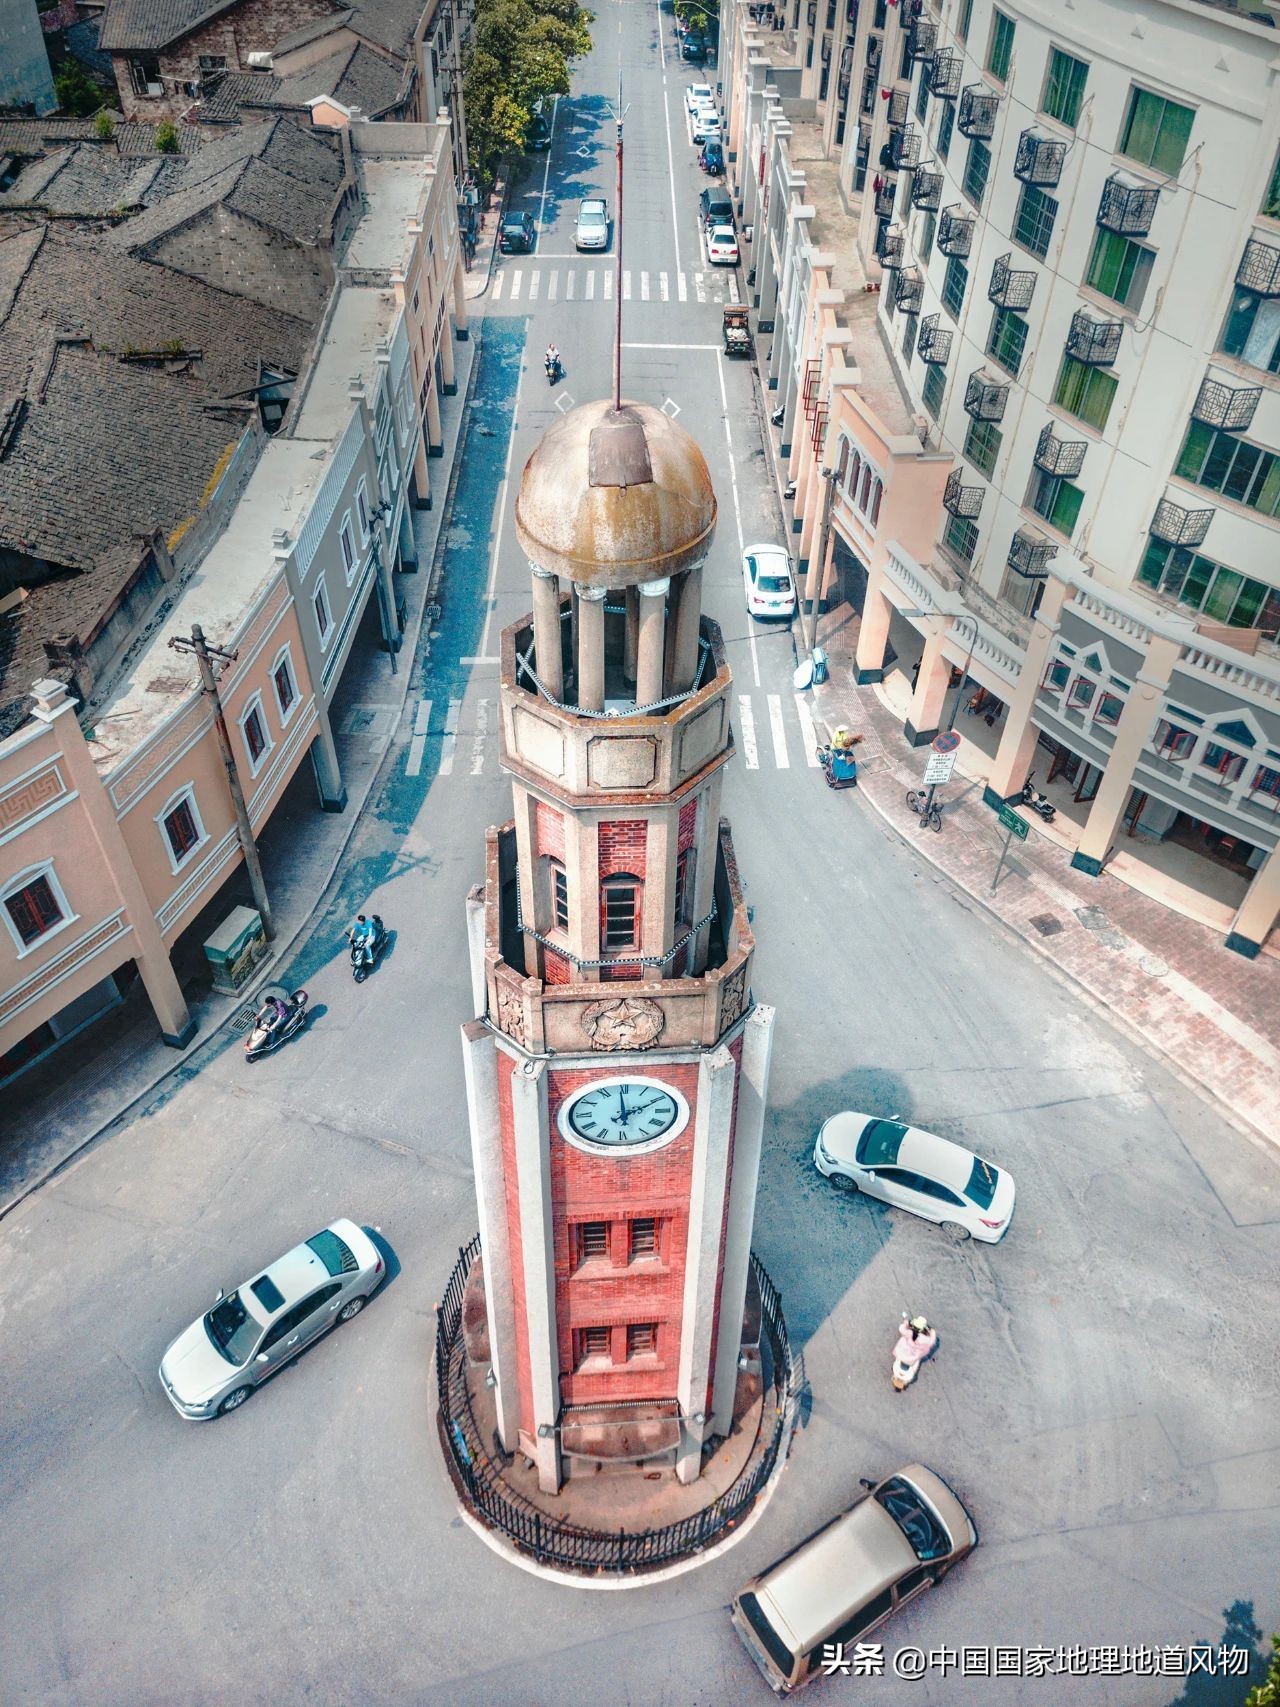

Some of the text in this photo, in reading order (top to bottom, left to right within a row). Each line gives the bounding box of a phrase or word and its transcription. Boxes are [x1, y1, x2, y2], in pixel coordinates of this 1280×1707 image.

[597, 1087, 612, 1099] XI
[619, 1084, 629, 1095] XII
[581, 1099, 598, 1107] X
[618, 1130, 628, 1141] VI
